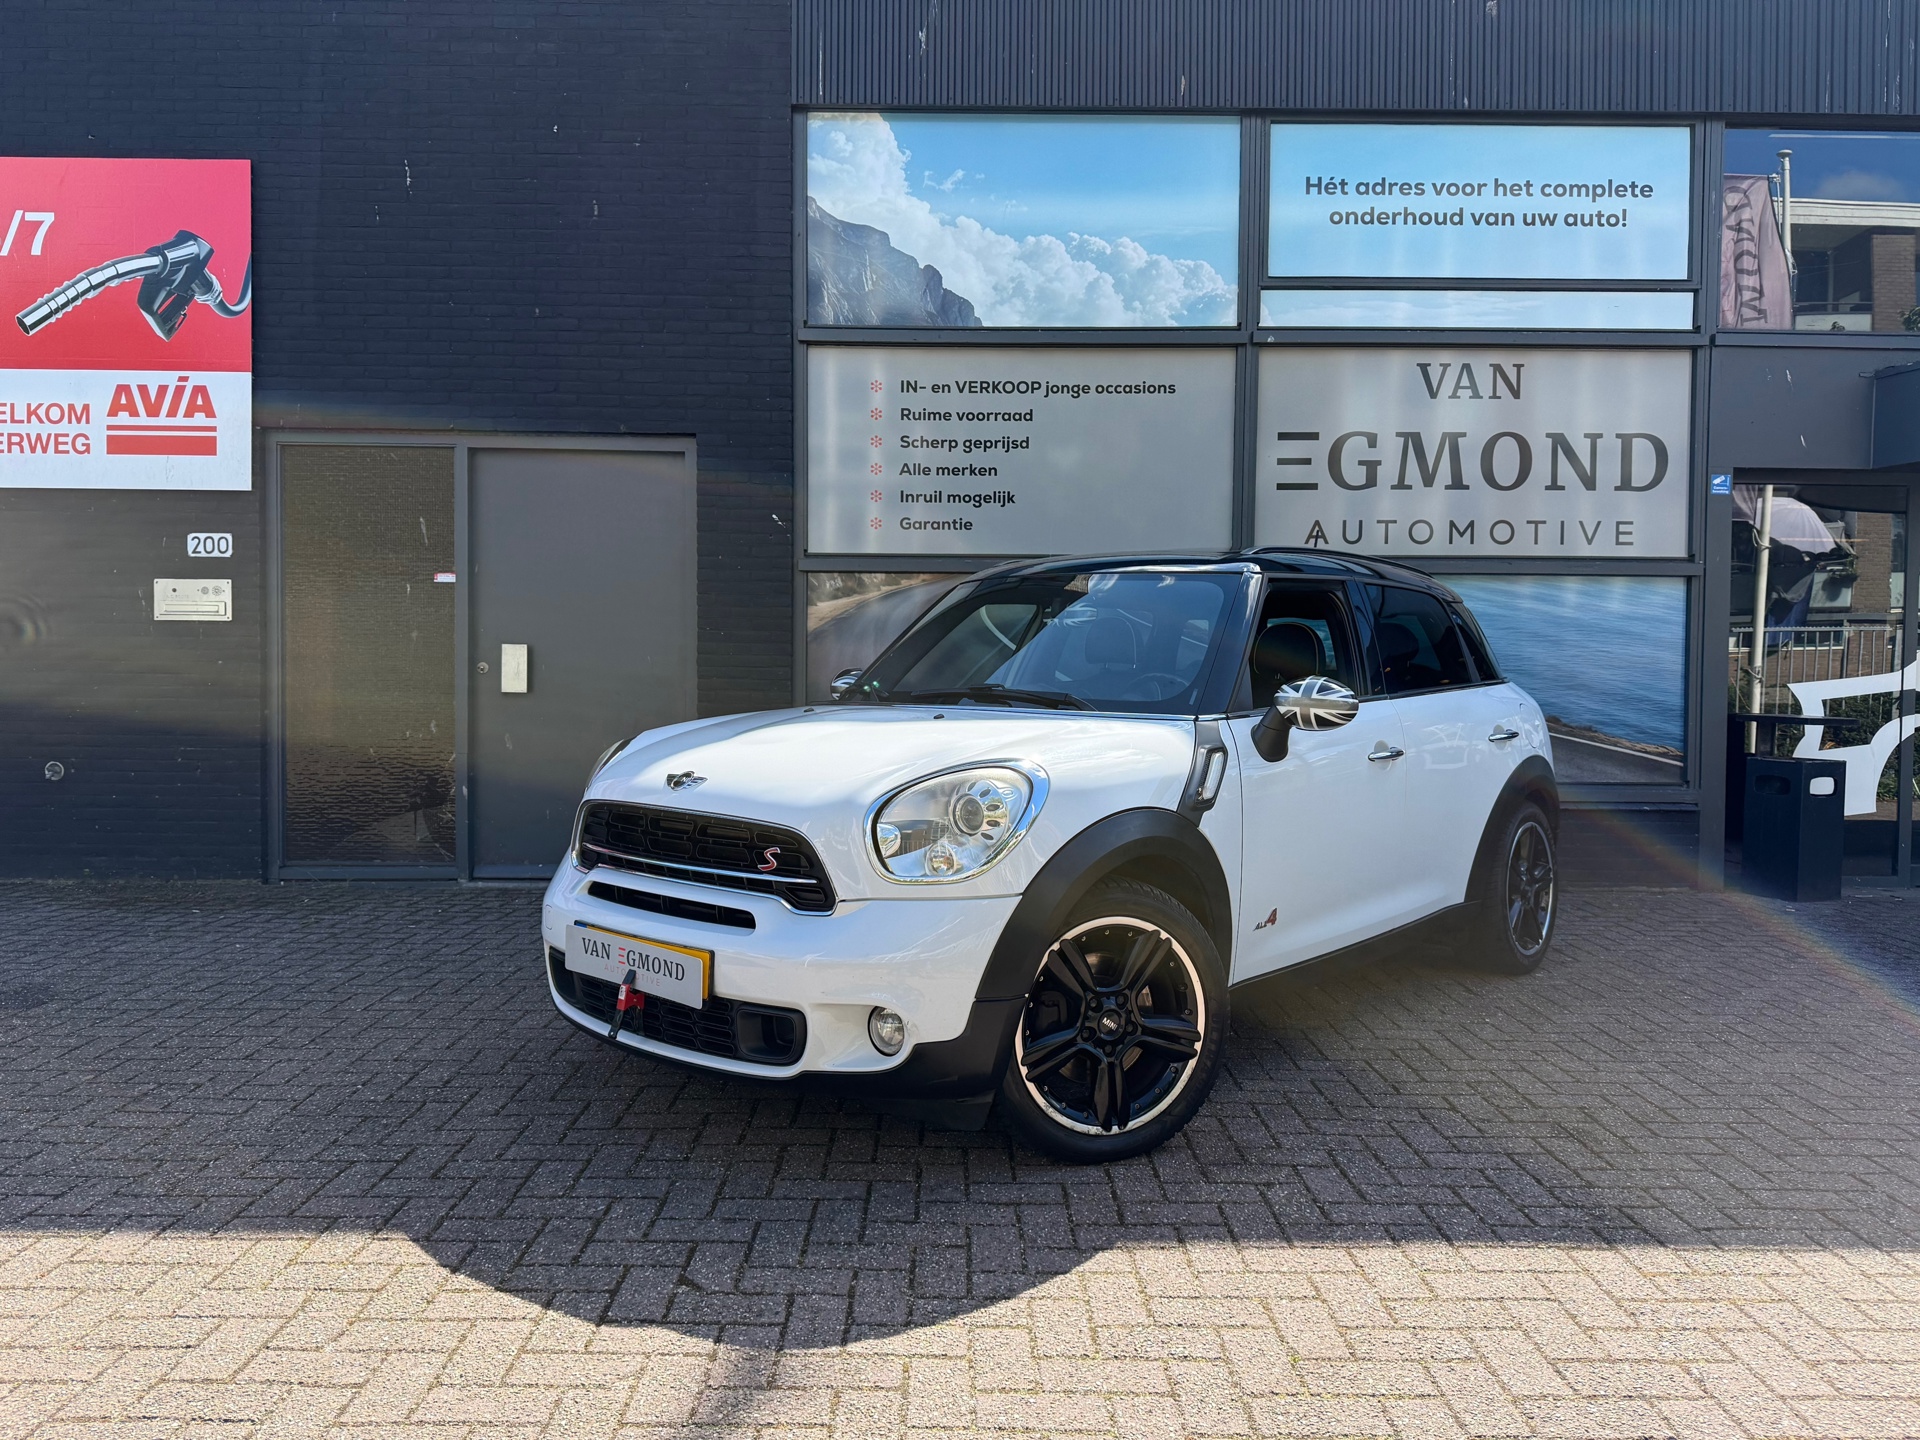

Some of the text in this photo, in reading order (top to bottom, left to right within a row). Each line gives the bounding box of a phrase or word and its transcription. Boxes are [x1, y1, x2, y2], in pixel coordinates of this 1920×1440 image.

[1305, 176, 1654, 203] Hét adres voor het complete
[1329, 206, 1628, 228] onderhoud van uw auto!
[0, 209, 55, 257] /7
[900, 380, 1177, 399] IN- en VERKOOP jonge occasions
[1416, 362, 1525, 400] VAN
[900, 407, 1034, 422] Ruime voorraad
[0, 432, 91, 455] RWEG
[900, 435, 1030, 454] Scherp geprijsd
[899, 463, 998, 477] Alle merken
[900, 490, 1016, 508] Inruil mogelijk
[899, 517, 974, 531] Garantie
[1304, 518, 1635, 547] AUTOMOTIVE
[190, 535, 230, 555] 200
[581, 936, 612, 960] VAN
[603, 963, 662, 987] AUTOOTIVE
